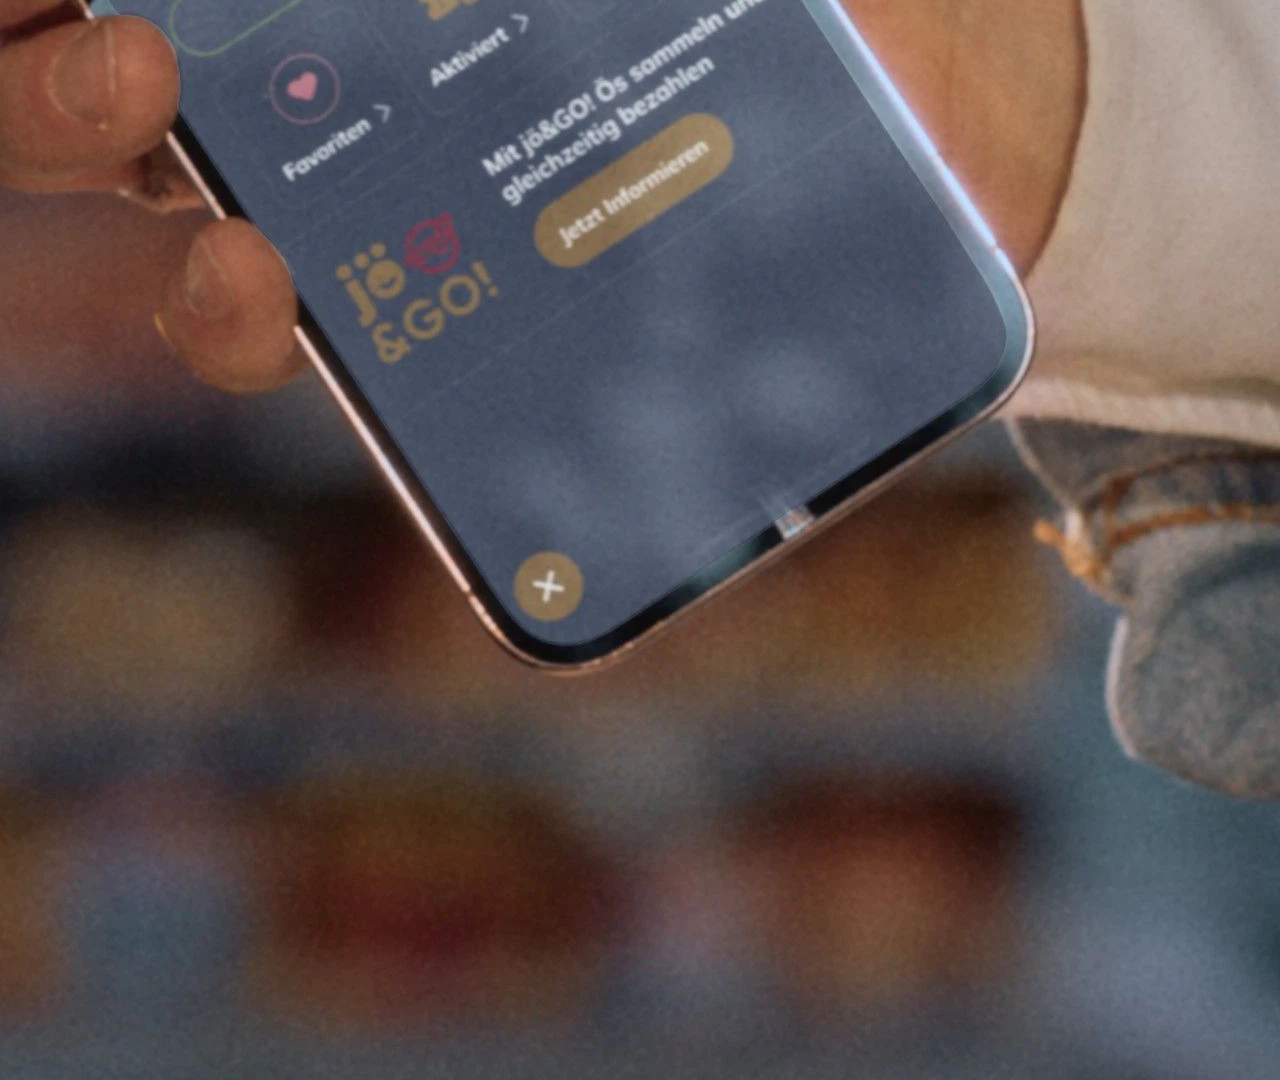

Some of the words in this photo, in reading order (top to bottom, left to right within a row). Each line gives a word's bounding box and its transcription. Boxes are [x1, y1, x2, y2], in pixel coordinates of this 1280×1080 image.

[429, 25, 511, 88] Aktiviert
[480, 142, 523, 178] Mit
[518, 92, 597, 161] jö&GO!
[593, 74, 630, 105] Ös
[628, 12, 724, 83] sammeln
[281, 117, 372, 182] Favoriten
[501, 114, 622, 207] gleichzeitig
[617, 55, 716, 127] bezahlen
[558, 206, 606, 249] Jetzt
[602, 139, 710, 214] Informieren
[335, 241, 406, 328] jö
[371, 260, 499, 364] &GO!
